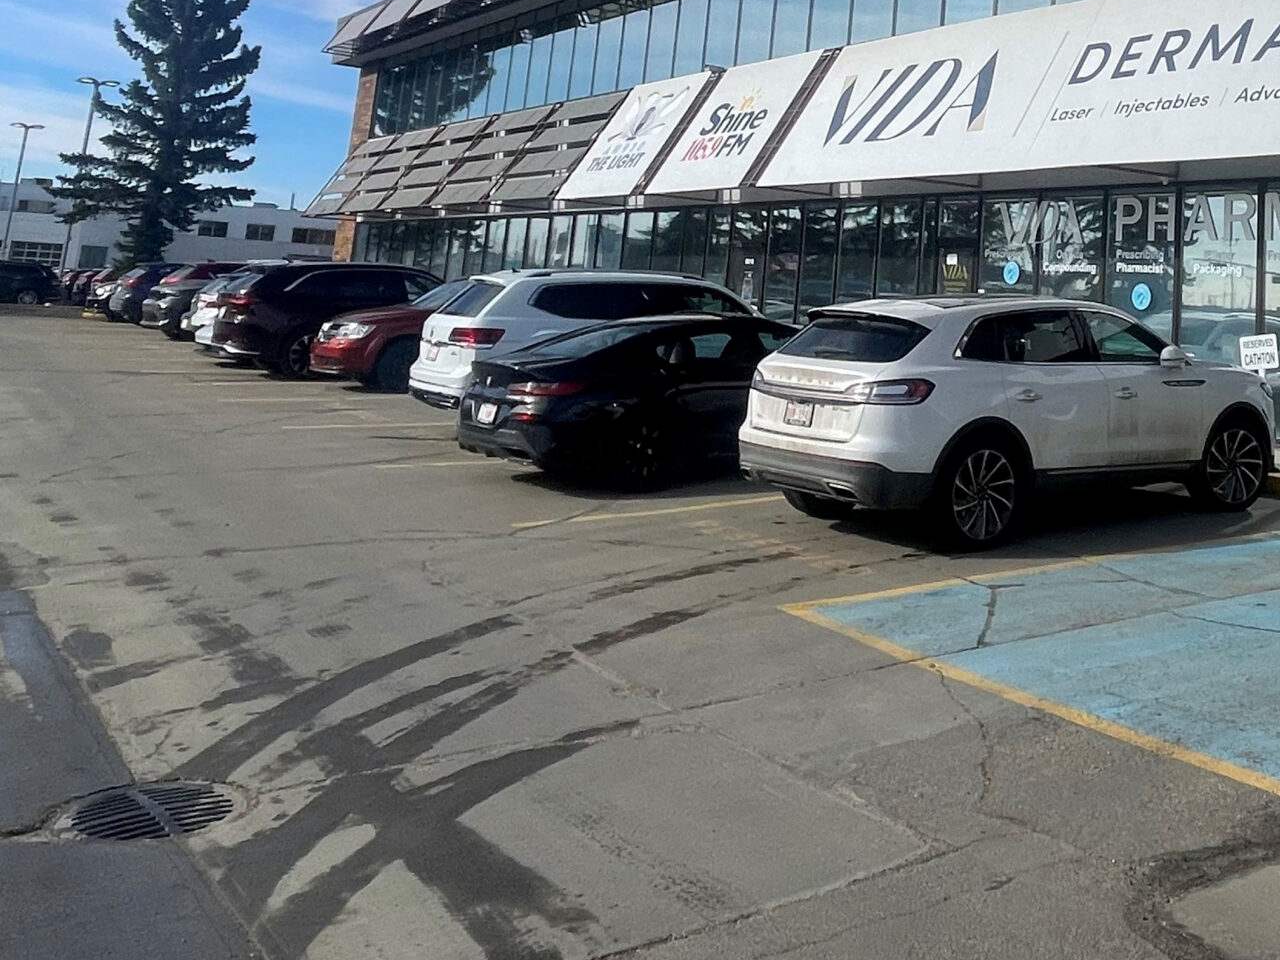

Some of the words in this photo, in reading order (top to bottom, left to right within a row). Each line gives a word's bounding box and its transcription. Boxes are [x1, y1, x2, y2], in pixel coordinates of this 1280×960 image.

[823, 49, 1000, 148] VIDA
[1050, 106, 1094, 122] Laser
[1114, 93, 1210, 118] Injectables
[700, 102, 769, 136] Shine
[608, 151, 646, 170] LIGHT
[1115, 262, 1165, 274] Pharmacist
[1192, 263, 1243, 278] Packaging
